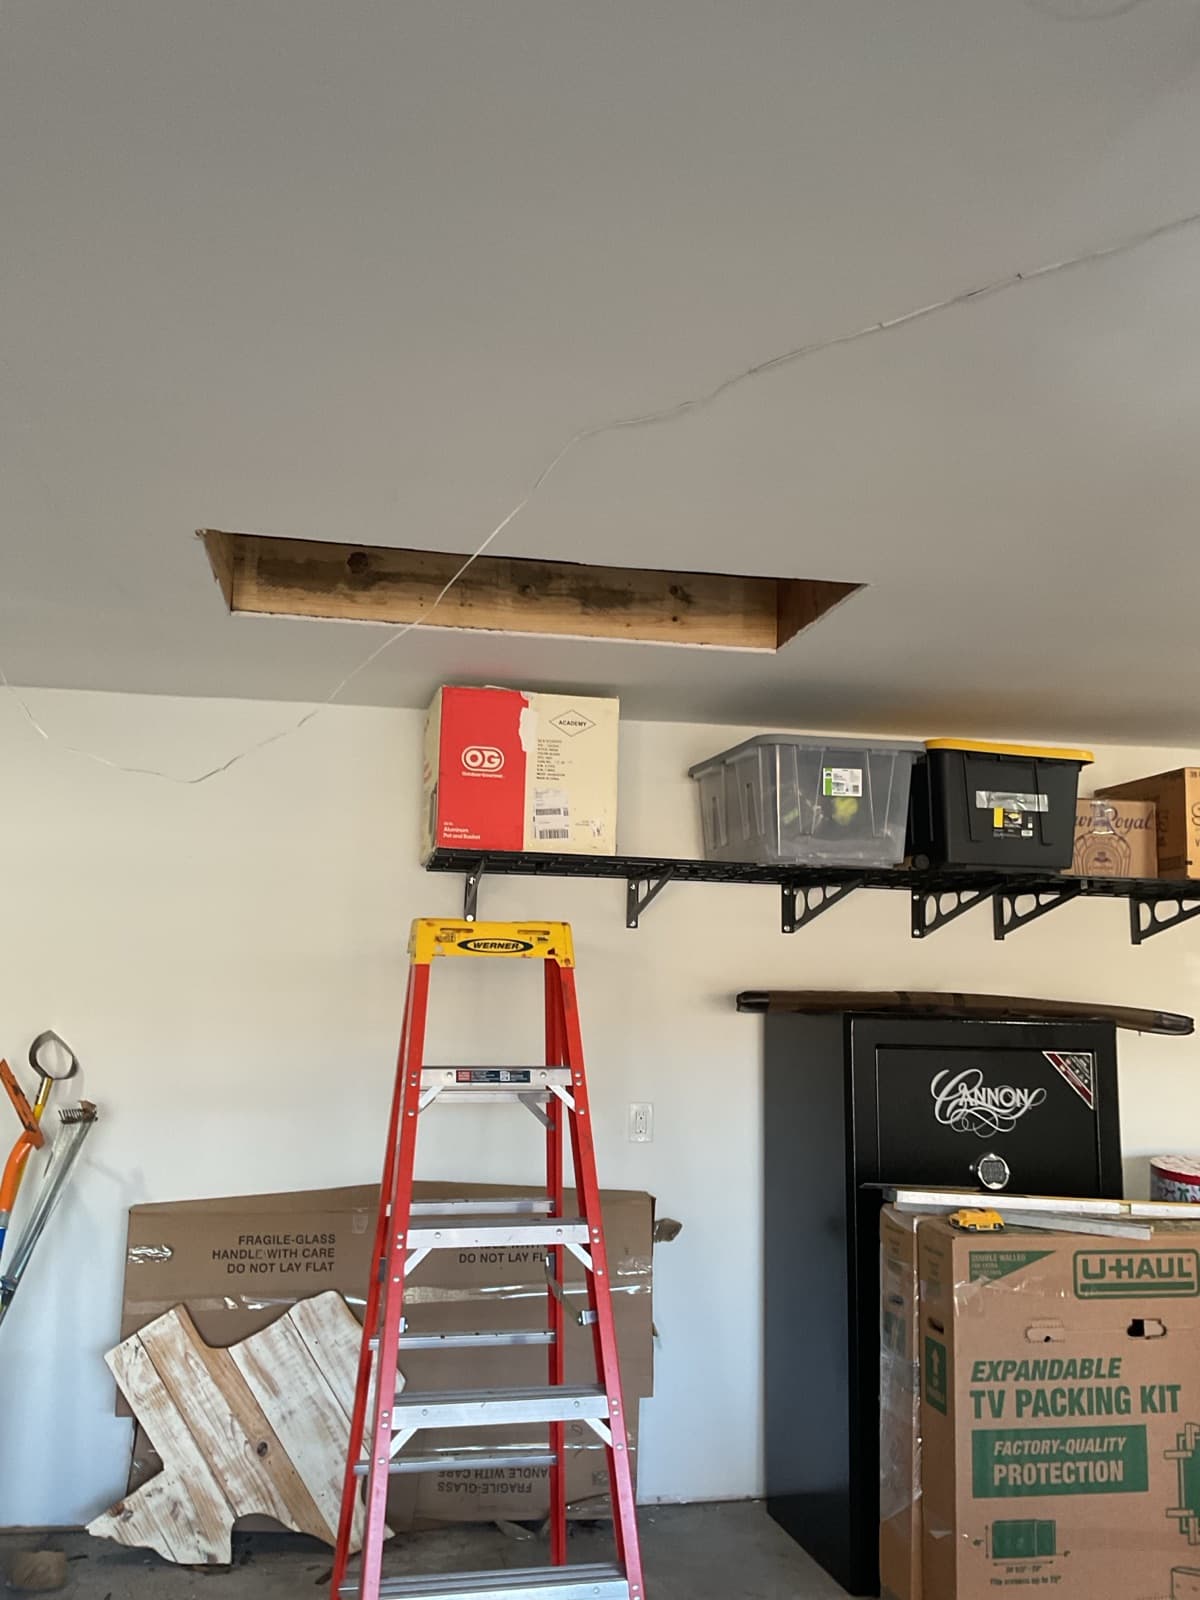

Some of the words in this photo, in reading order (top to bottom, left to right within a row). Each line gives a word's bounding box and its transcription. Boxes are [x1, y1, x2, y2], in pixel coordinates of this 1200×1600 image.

[464, 748, 502, 769] OG
[473, 941, 521, 951] WERNER
[238, 1233, 336, 1245] FRAGILE-GLASS
[212, 1249, 263, 1260] HANDLE
[267, 1248, 298, 1259] WITH
[302, 1247, 335, 1259] CARE
[459, 1253, 476, 1264] DO
[480, 1253, 505, 1263] NOT
[508, 1252, 529, 1263] LAY
[532, 1252, 547, 1263] FL
[227, 1263, 246, 1274] DO
[249, 1263, 276, 1273] NOT
[280, 1262, 302, 1273] LAY
[305, 1261, 335, 1273] FLAT
[970, 1357, 1122, 1383] EXPANDABLE
[969, 1389, 1006, 1419] TV
[1015, 1385, 1131, 1419] PACKING
[1140, 1384, 1182, 1414] KIT
[993, 1437, 1128, 1457] FACTORY-QUALITY
[474, 1468, 504, 1479] WITH
[509, 1467, 549, 1479] ANDLE
[993, 1460, 1124, 1486] PROTECTION
[437, 1481, 533, 1494] FRAGILE-GLASS
